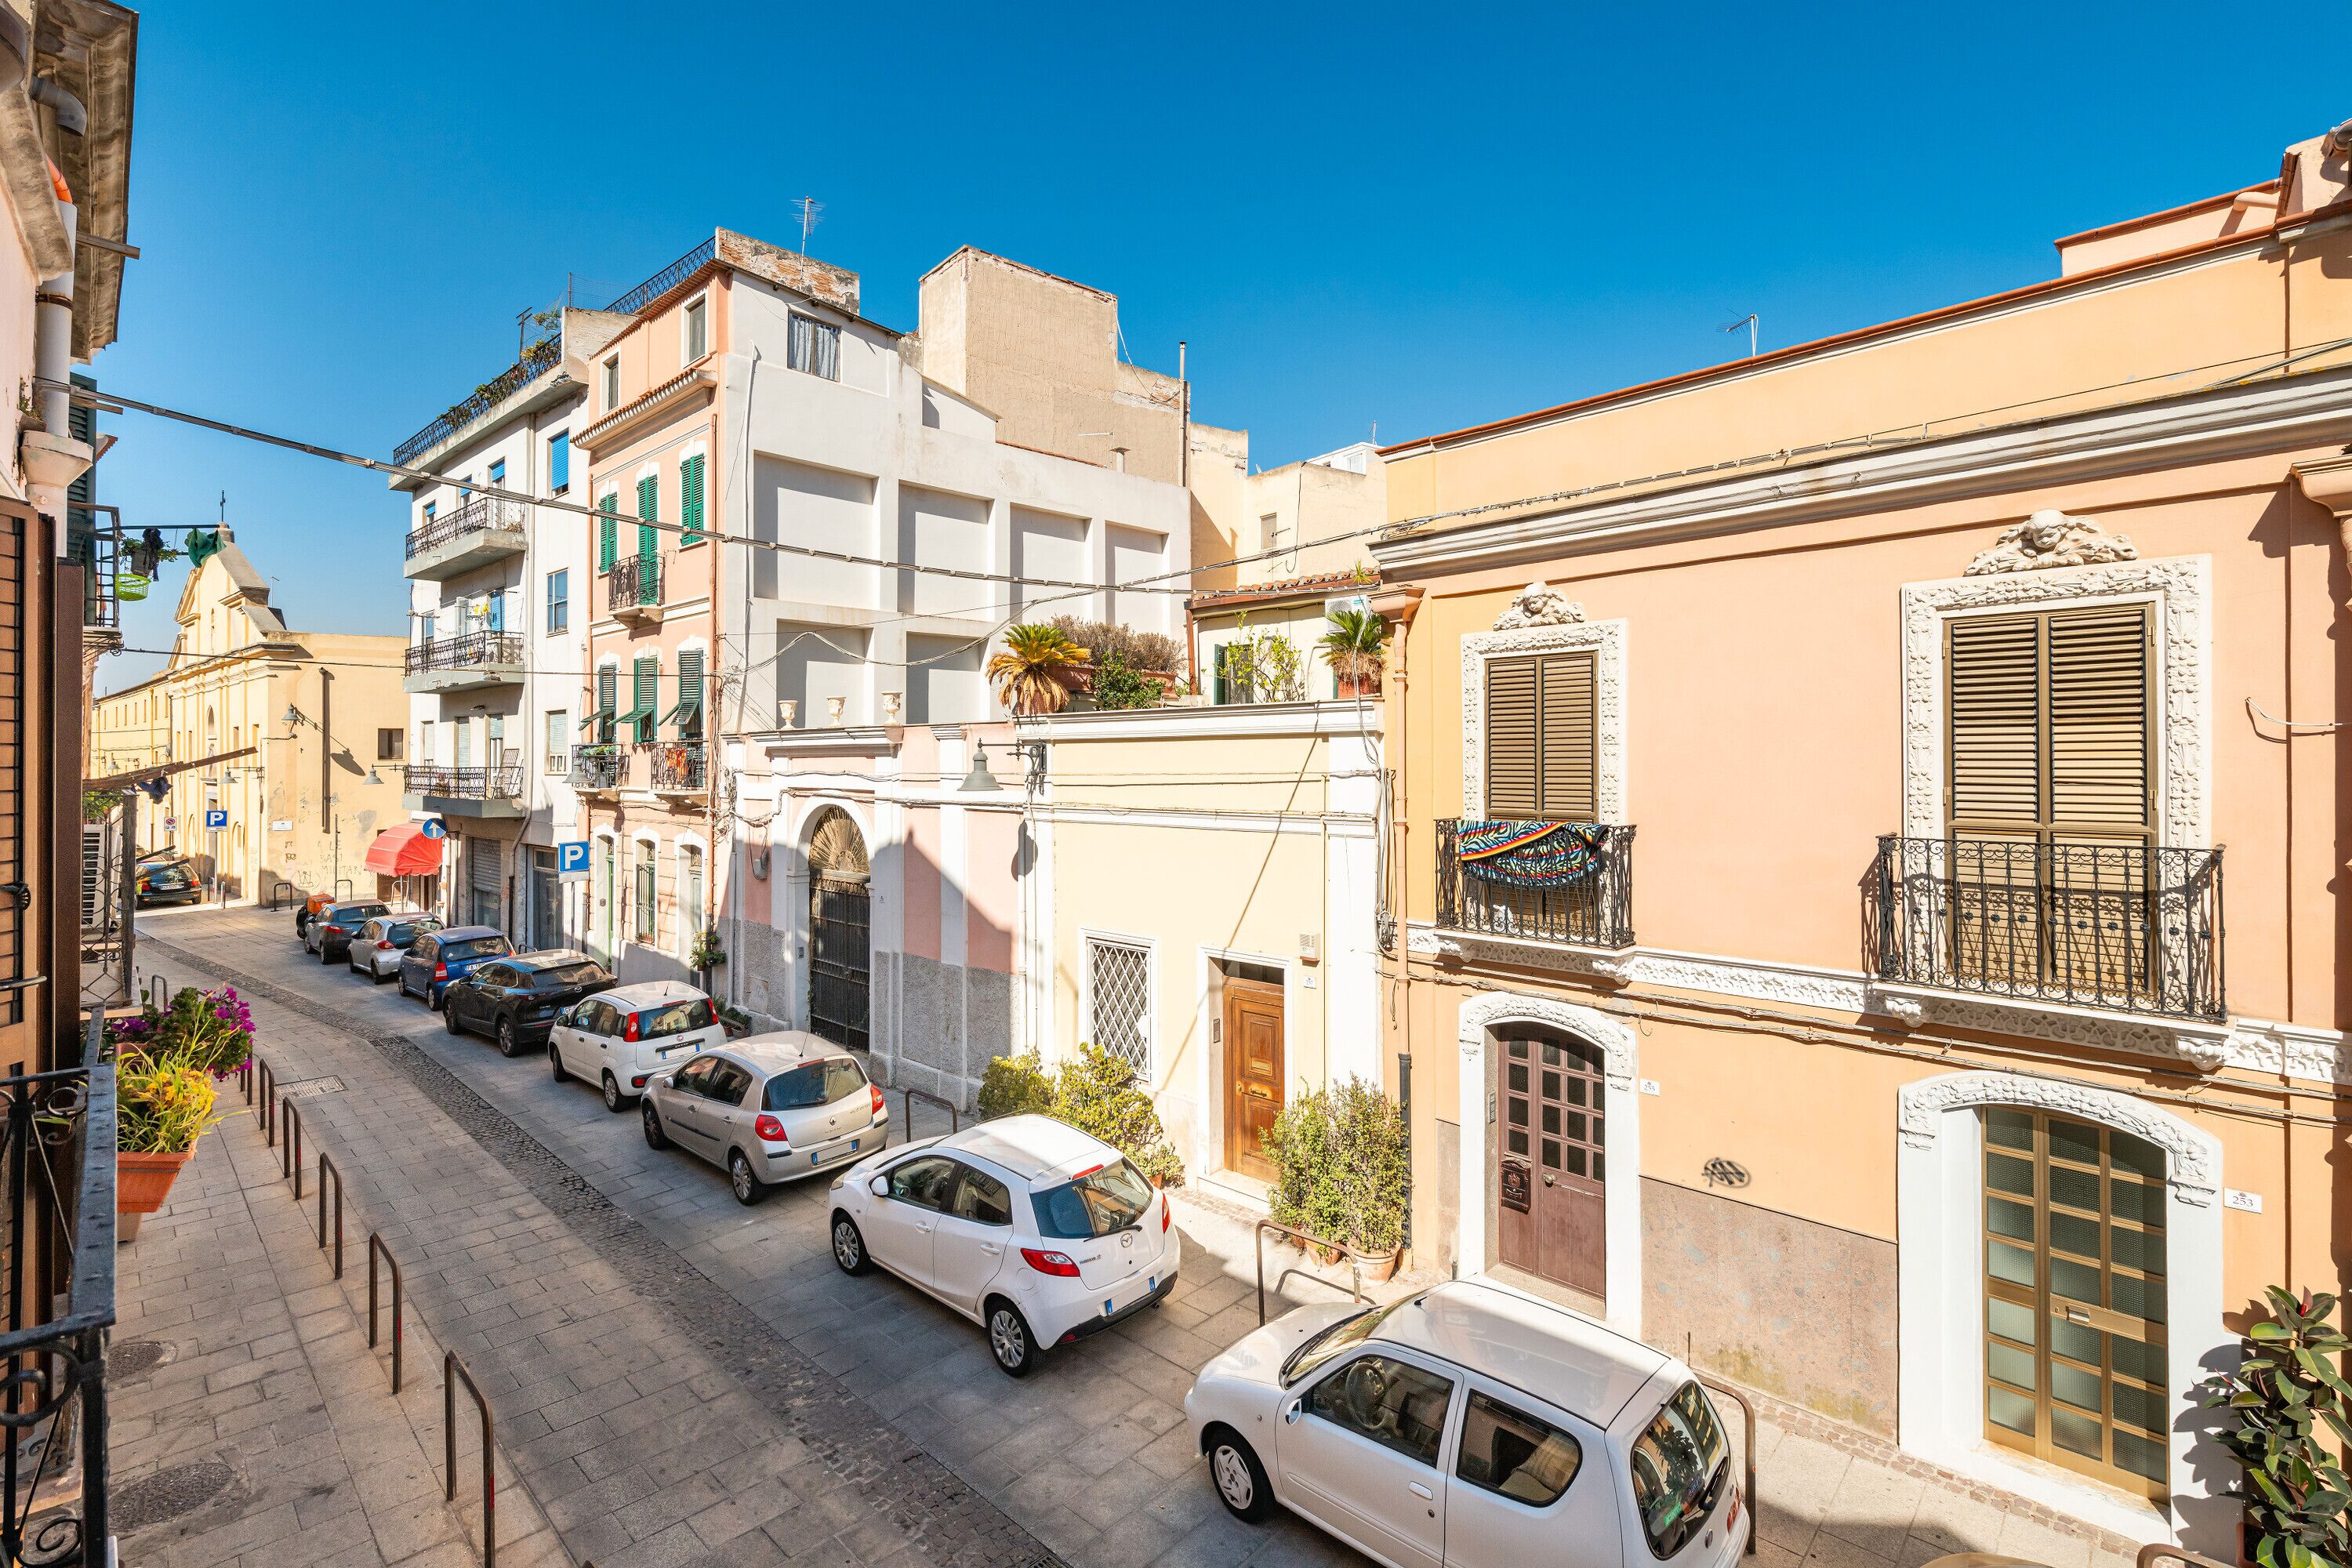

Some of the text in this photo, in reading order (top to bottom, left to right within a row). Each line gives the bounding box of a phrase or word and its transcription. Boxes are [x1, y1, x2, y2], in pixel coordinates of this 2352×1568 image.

[209, 811, 224, 826] P
[564, 844, 584, 869] P
[2232, 1196, 2254, 1207] 253
